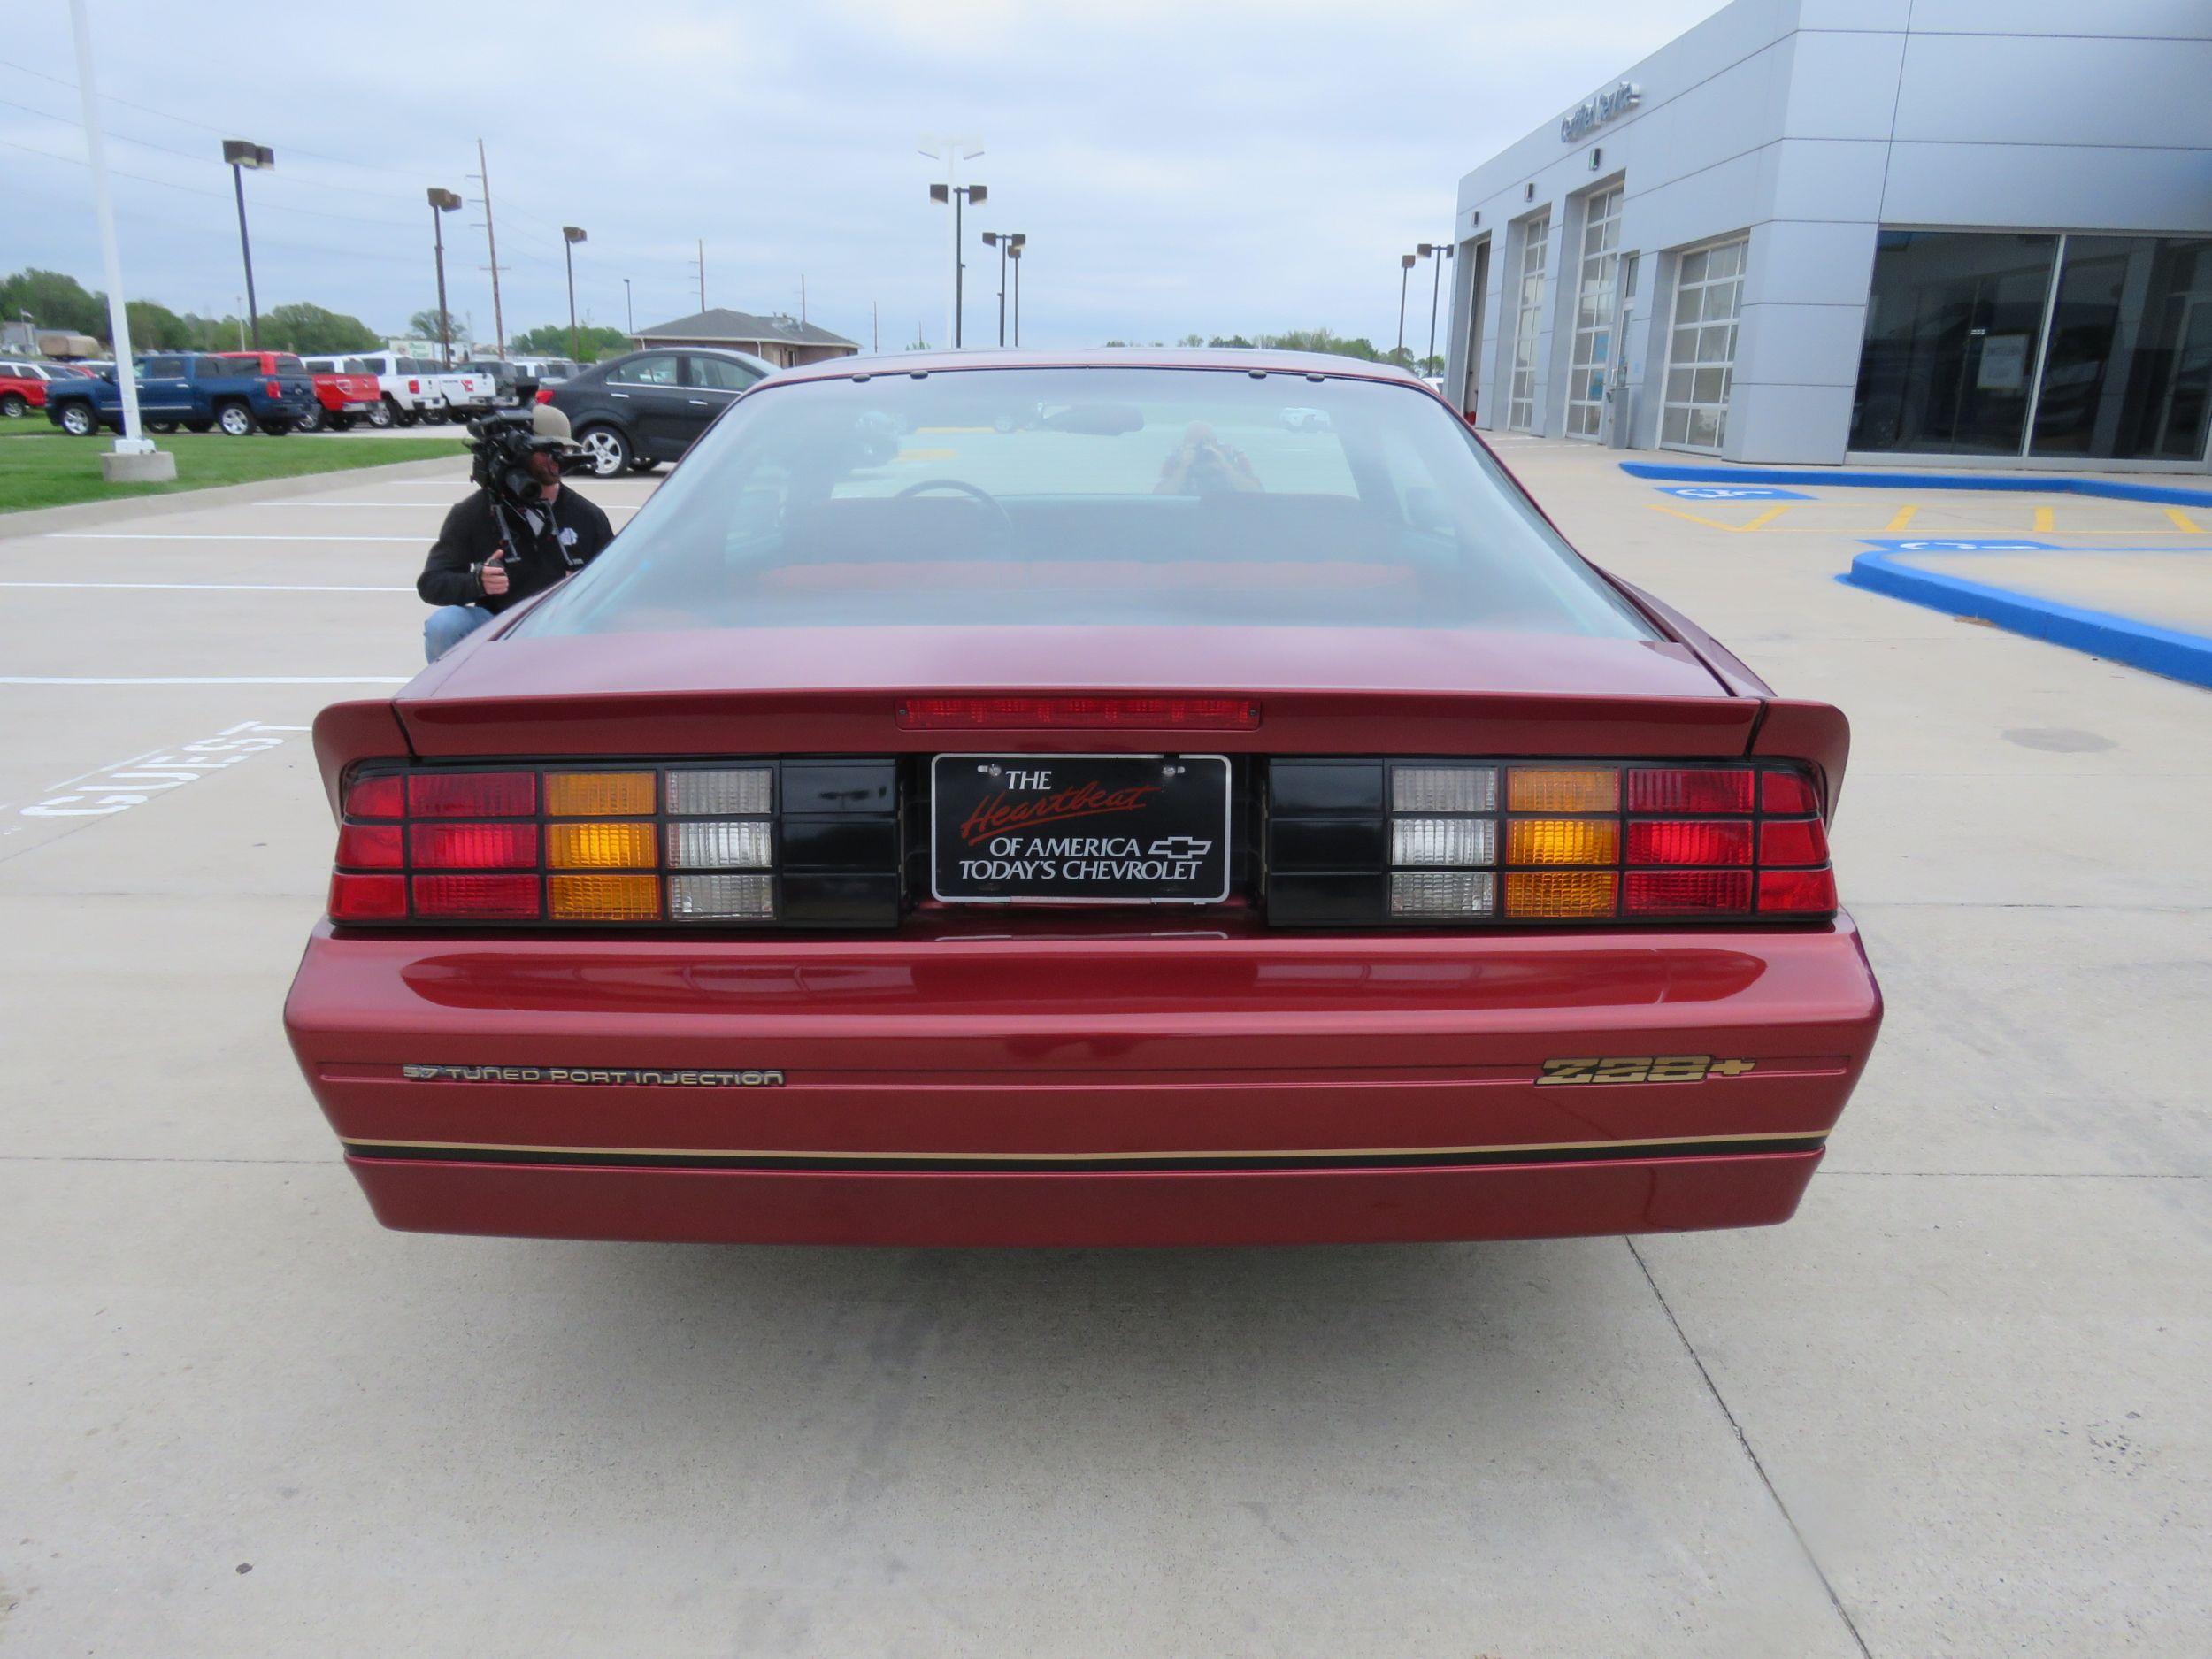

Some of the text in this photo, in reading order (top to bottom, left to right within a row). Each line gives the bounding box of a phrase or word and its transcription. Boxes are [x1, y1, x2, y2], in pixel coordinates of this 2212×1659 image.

[1005, 771, 1052, 790] THE
[961, 780, 1162, 845] Heartbeat
[989, 837, 1141, 857] OF AMERICA
[959, 860, 1202, 880] TODAY'S CHEVROLET
[446, 1067, 540, 1081] TUNED
[550, 1069, 626, 1084] PORT
[635, 1071, 784, 1086] INJECTION
